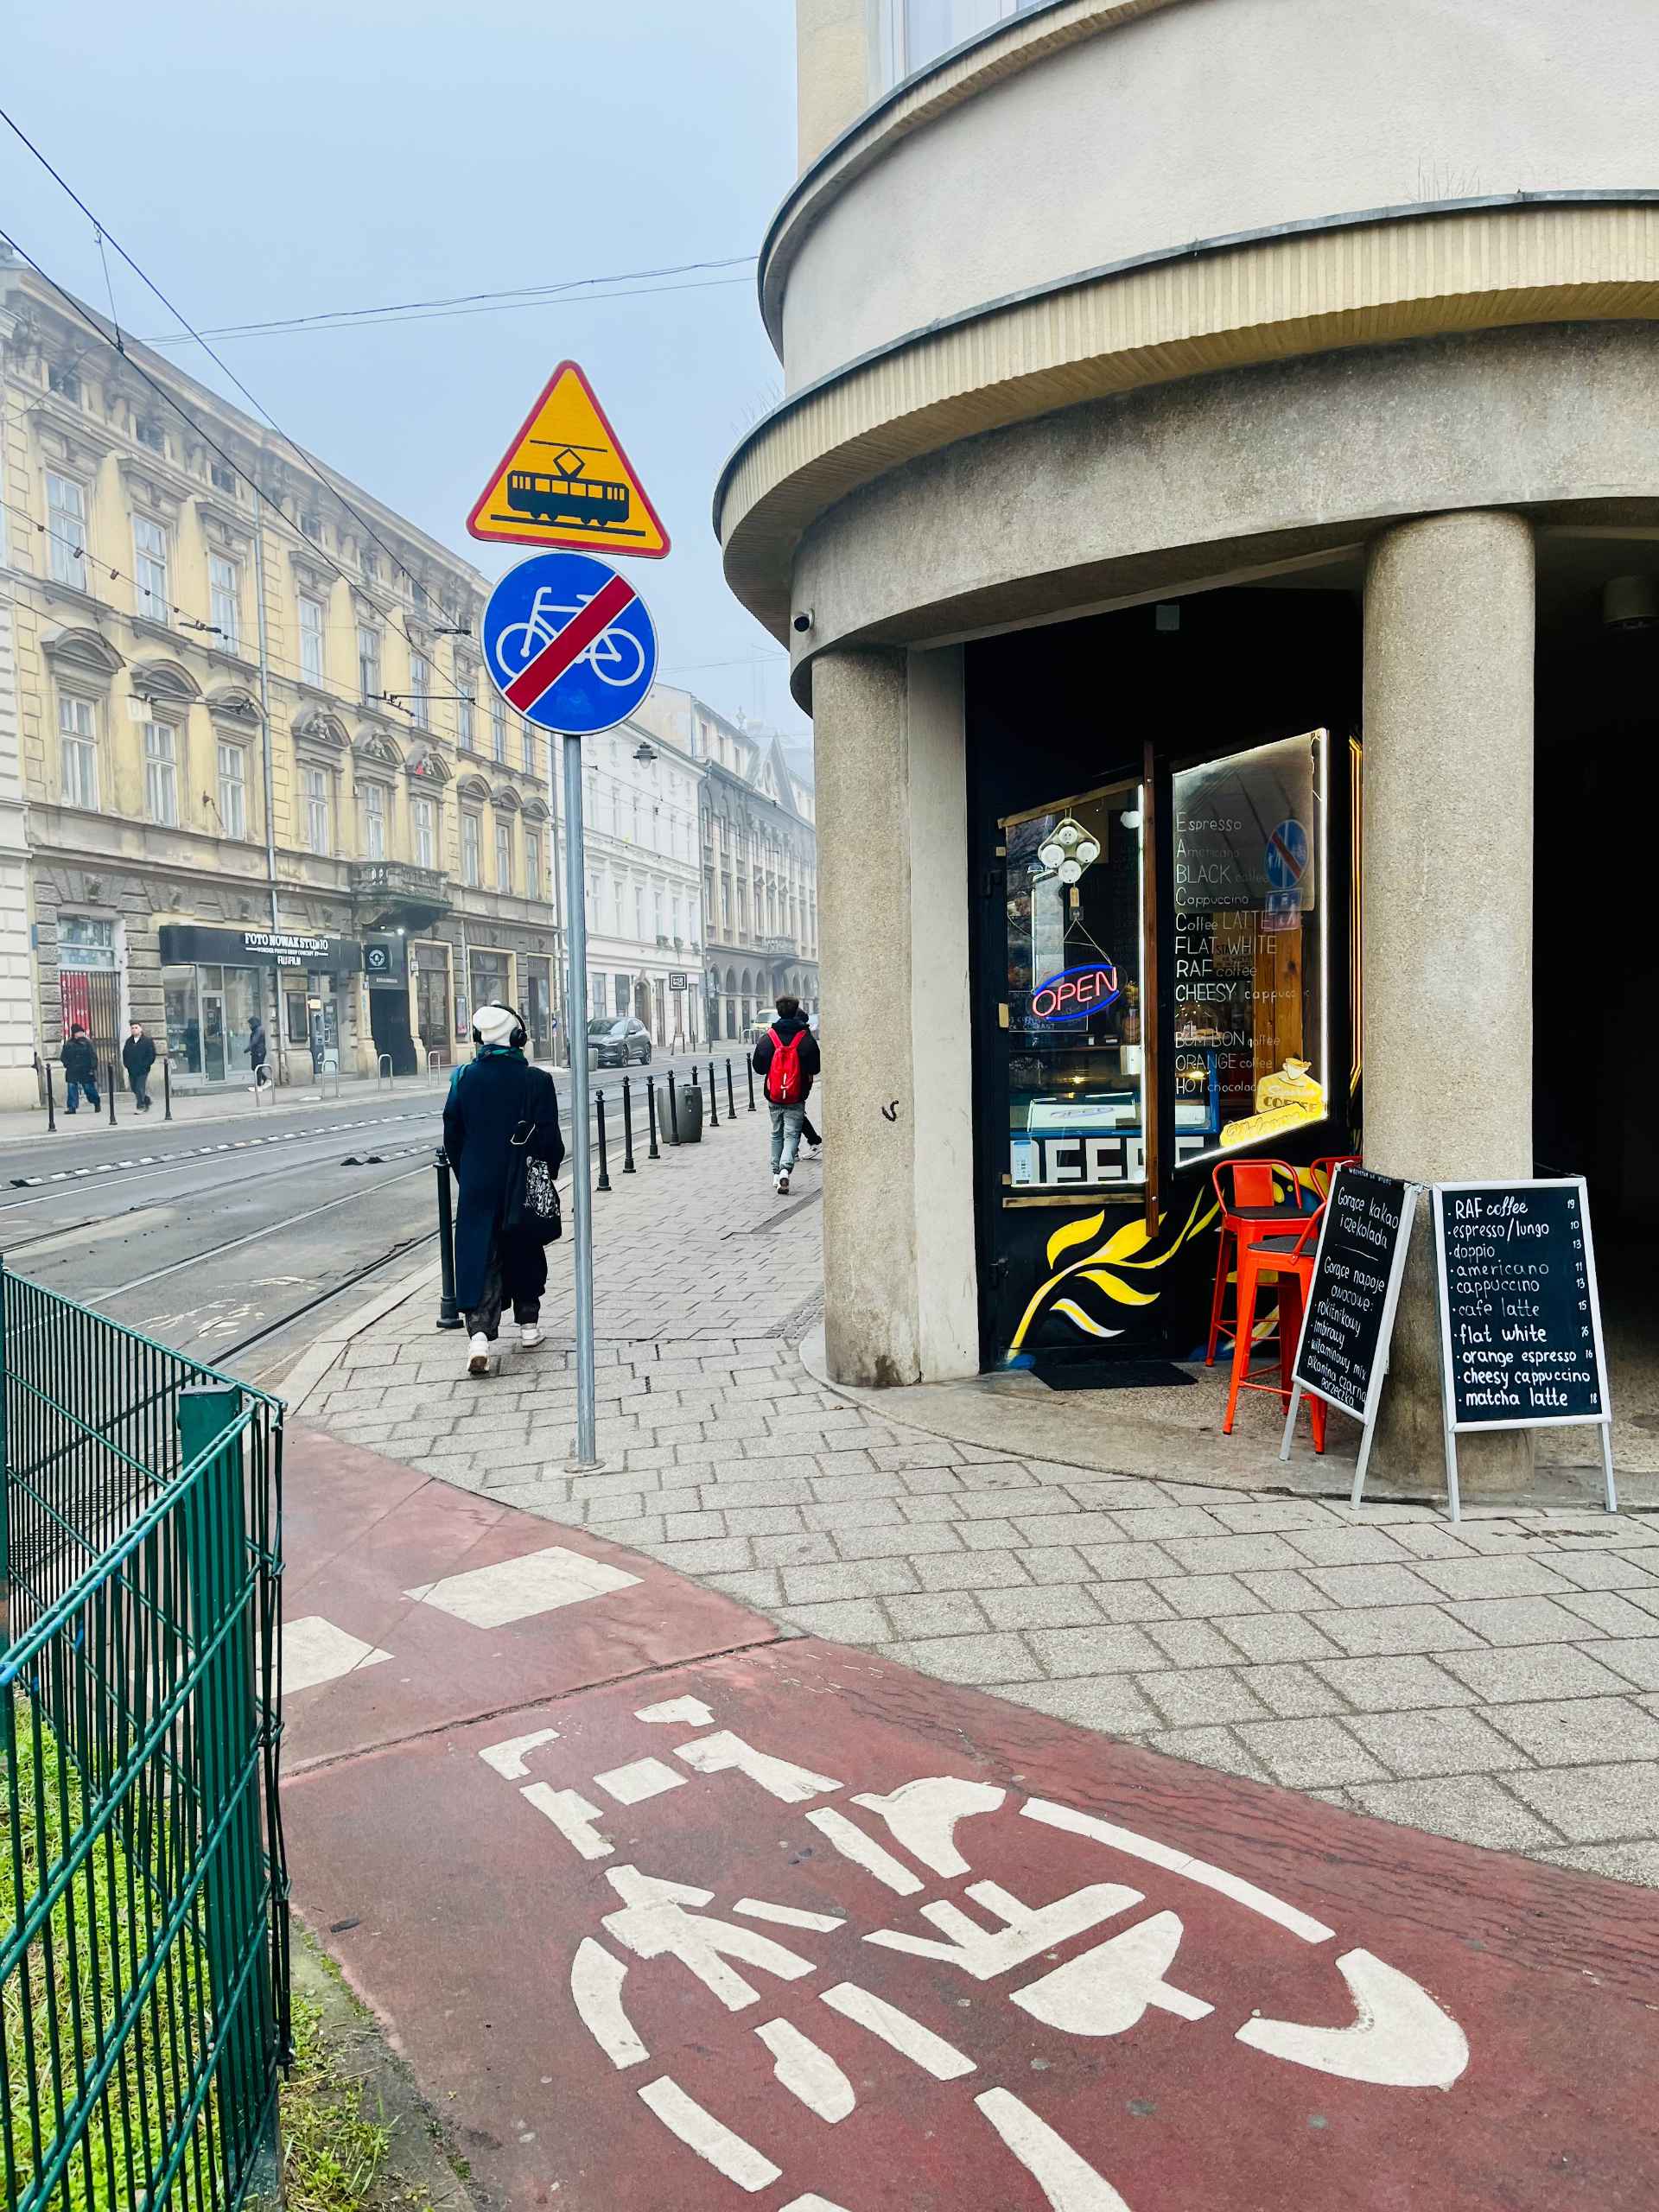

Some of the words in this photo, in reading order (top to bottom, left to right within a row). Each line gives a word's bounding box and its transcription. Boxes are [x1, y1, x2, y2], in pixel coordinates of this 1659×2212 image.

[1176, 812, 1242, 832] Espresso
[1176, 864, 1230, 884] BLACK
[1176, 887, 1249, 908] Cappuccino
[1175, 912, 1218, 932] Coffee
[1223, 911, 1272, 930] LATTE
[245, 933, 269, 945] FOTO
[269, 934, 299, 948] NOWAK
[1175, 937, 1218, 955] FLAT
[1227, 935, 1277, 955] WHITE
[1176, 960, 1212, 978] RAF
[1216, 961, 1257, 978] coffee
[1033, 967, 1117, 1017] OPEN
[1175, 982, 1237, 1002] CHEESY
[1175, 1053, 1237, 1071] ORANGE
[1239, 1057, 1273, 1069] coffee
[1176, 1077, 1203, 1095] HOT
[1338, 1186, 1365, 1211] Gorące
[1369, 1197, 1399, 1229] kakao
[1455, 1198, 1483, 1219] RAF
[1486, 1195, 1529, 1217] coffee
[1567, 1198, 1575, 1209] 19
[1344, 1216, 1388, 1249] czekolada
[1452, 1217, 1549, 1242] espresso/lungo
[1570, 1220, 1580, 1230] 10
[1453, 1243, 1496, 1263] doppio
[1573, 1239, 1582, 1249] 13
[1324, 1255, 1350, 1279] Gorące
[1353, 1269, 1385, 1294] napoje
[1457, 1260, 1549, 1277] americano
[1575, 1262, 1583, 1271] 11
[1457, 1279, 1541, 1299] cappuccino
[1575, 1278, 1586, 1289] 13
[1459, 1299, 1493, 1318] cafe
[1501, 1296, 1541, 1318] latte
[1578, 1300, 1587, 1311] 15
[1318, 1298, 1361, 1338] rokitnikowy
[1313, 1320, 1345, 1350] imbirowy
[1460, 1324, 1492, 1345] flat
[1502, 1324, 1548, 1343] white
[1463, 1350, 1514, 1368] orange
[1522, 1349, 1577, 1367] espresso
[1586, 1349, 1593, 1359] 16
[1353, 1363, 1367, 1381] mix
[1464, 1368, 1509, 1390] cheesy
[1515, 1368, 1591, 1387] cappuccino
[1339, 1376, 1367, 1402] czarna
[1465, 1387, 1521, 1407] matcha
[1529, 1386, 1568, 1407] latte
[1590, 1392, 1598, 1404] 18
